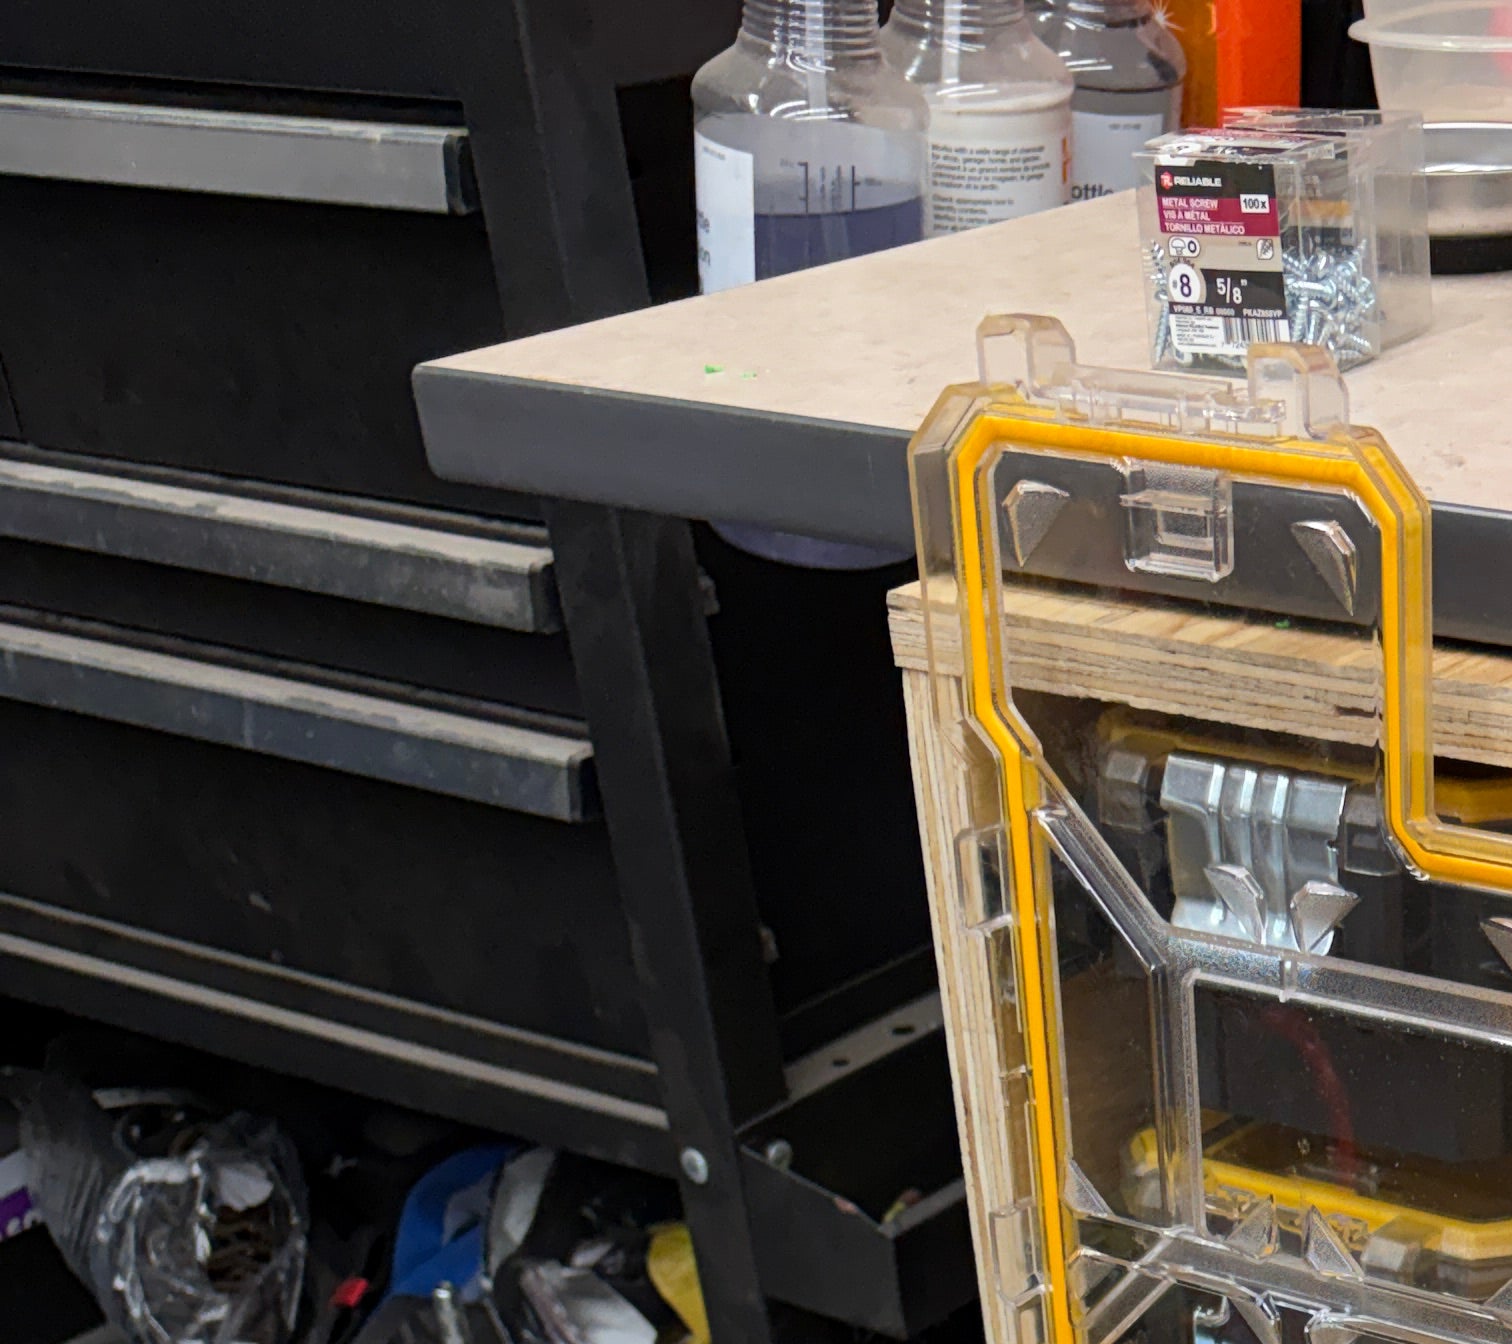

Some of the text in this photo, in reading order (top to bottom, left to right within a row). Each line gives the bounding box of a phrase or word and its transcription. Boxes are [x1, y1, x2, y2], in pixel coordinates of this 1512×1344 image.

[1173, 176, 1222, 187] RELIABLE
[1161, 197, 1219, 209] METAL SCREW
[1164, 222, 1203, 234] TORNILLO
